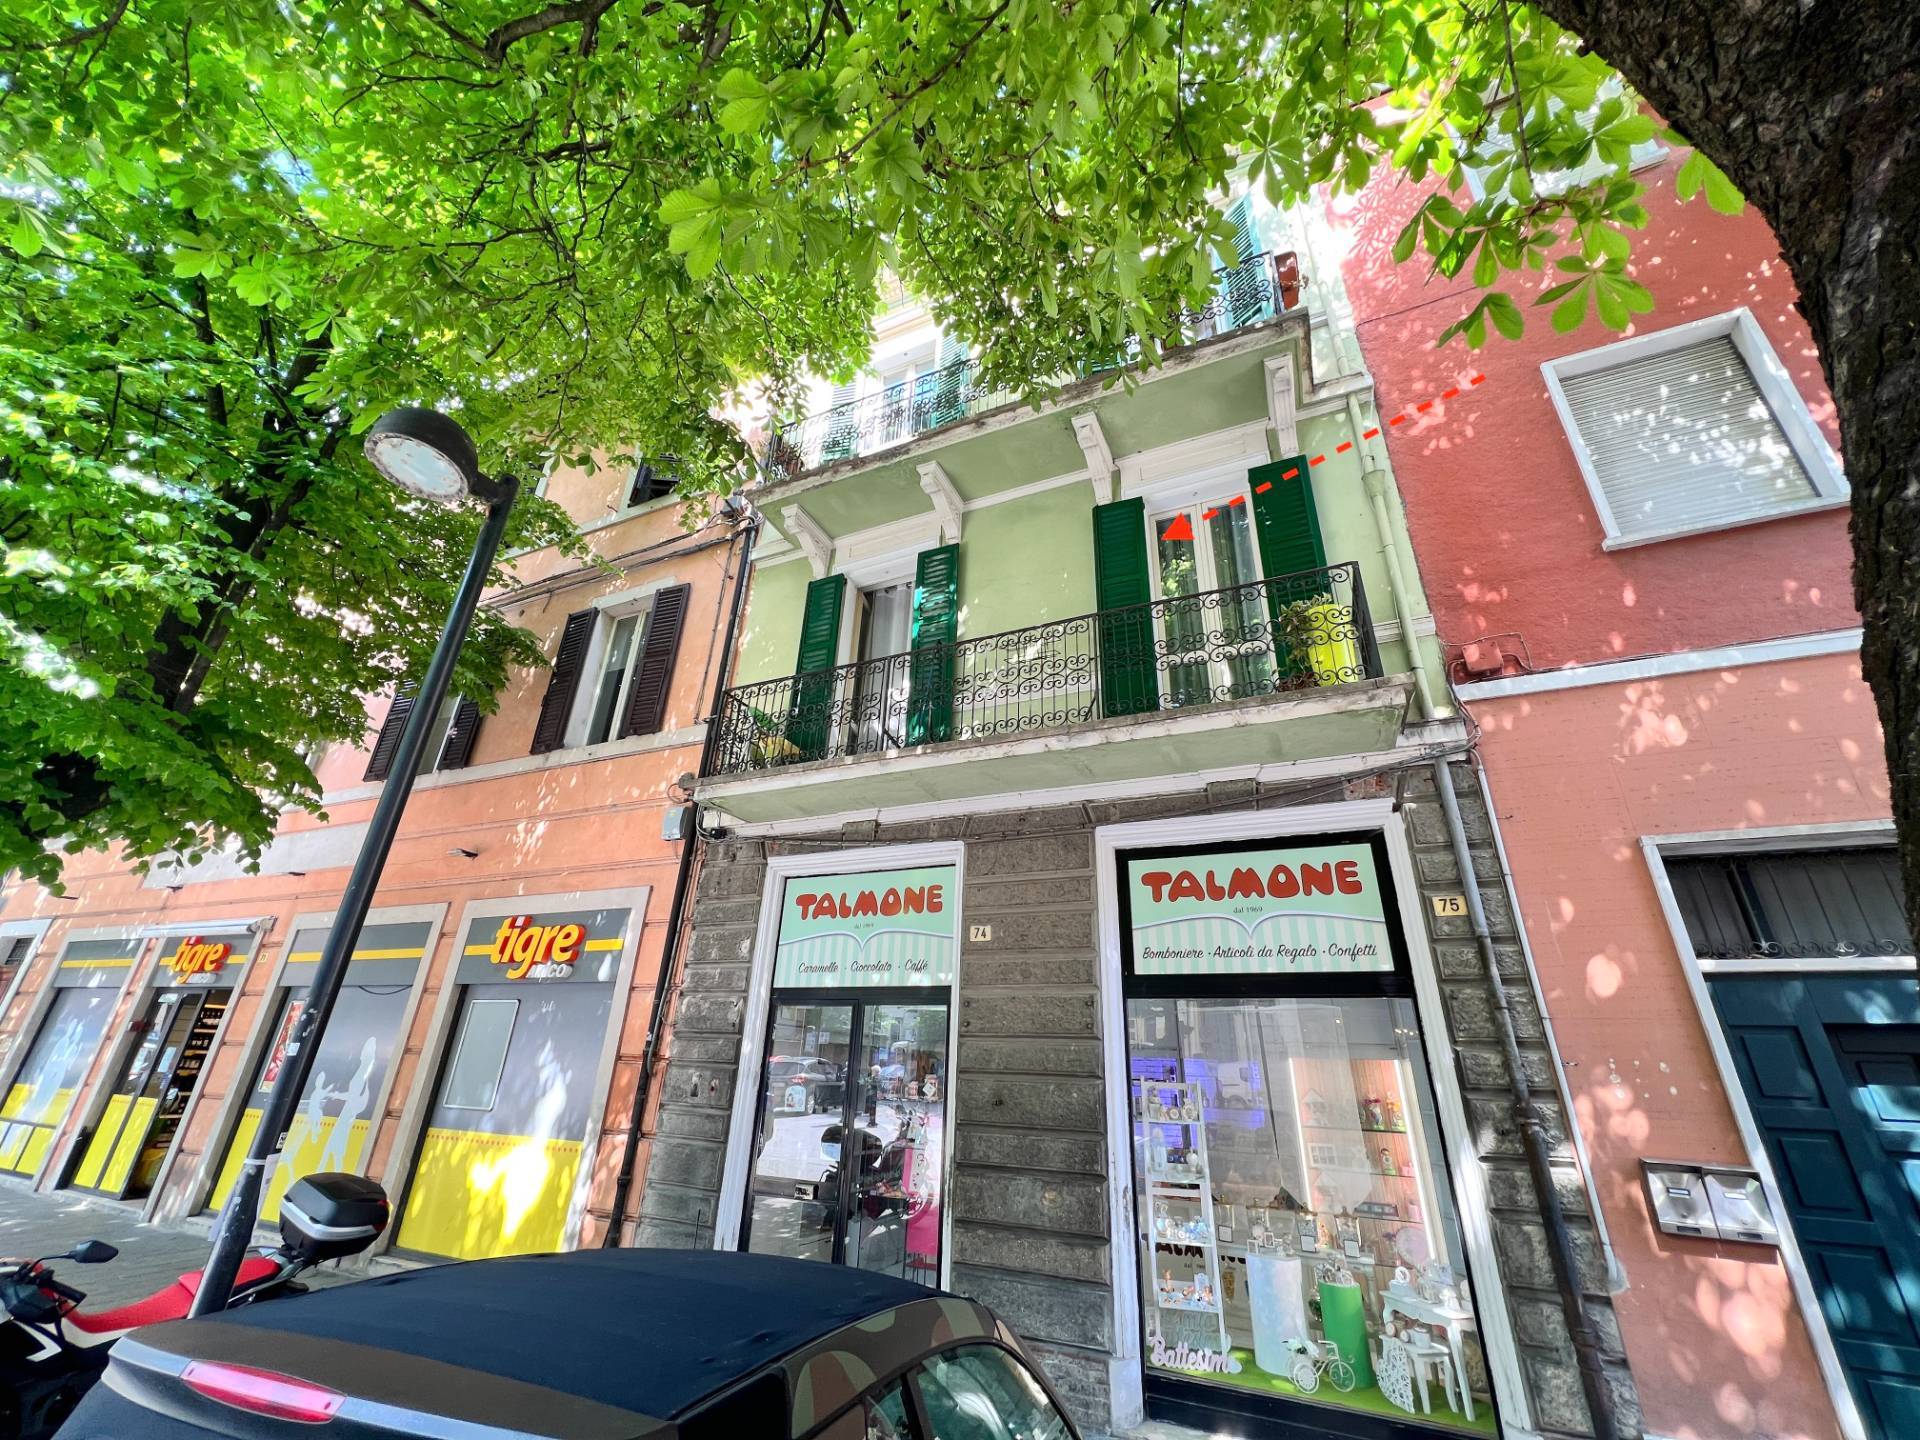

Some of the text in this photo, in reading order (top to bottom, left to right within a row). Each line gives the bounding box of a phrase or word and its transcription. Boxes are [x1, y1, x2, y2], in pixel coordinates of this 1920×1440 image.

[1141, 860, 1363, 903] TALMONE
[796, 884, 943, 920] TALMONE
[1246, 905, 1263, 913] 1969
[1438, 898, 1460, 912] 75
[974, 927, 987, 939] 74
[490, 914, 585, 980] tigre
[1142, 943, 1378, 964] Bomboniere Articoli da Regalo Confetti
[174, 936, 231, 984] tigre
[798, 962, 838, 973] Caramelle
[850, 959, 892, 972] Cioccolato
